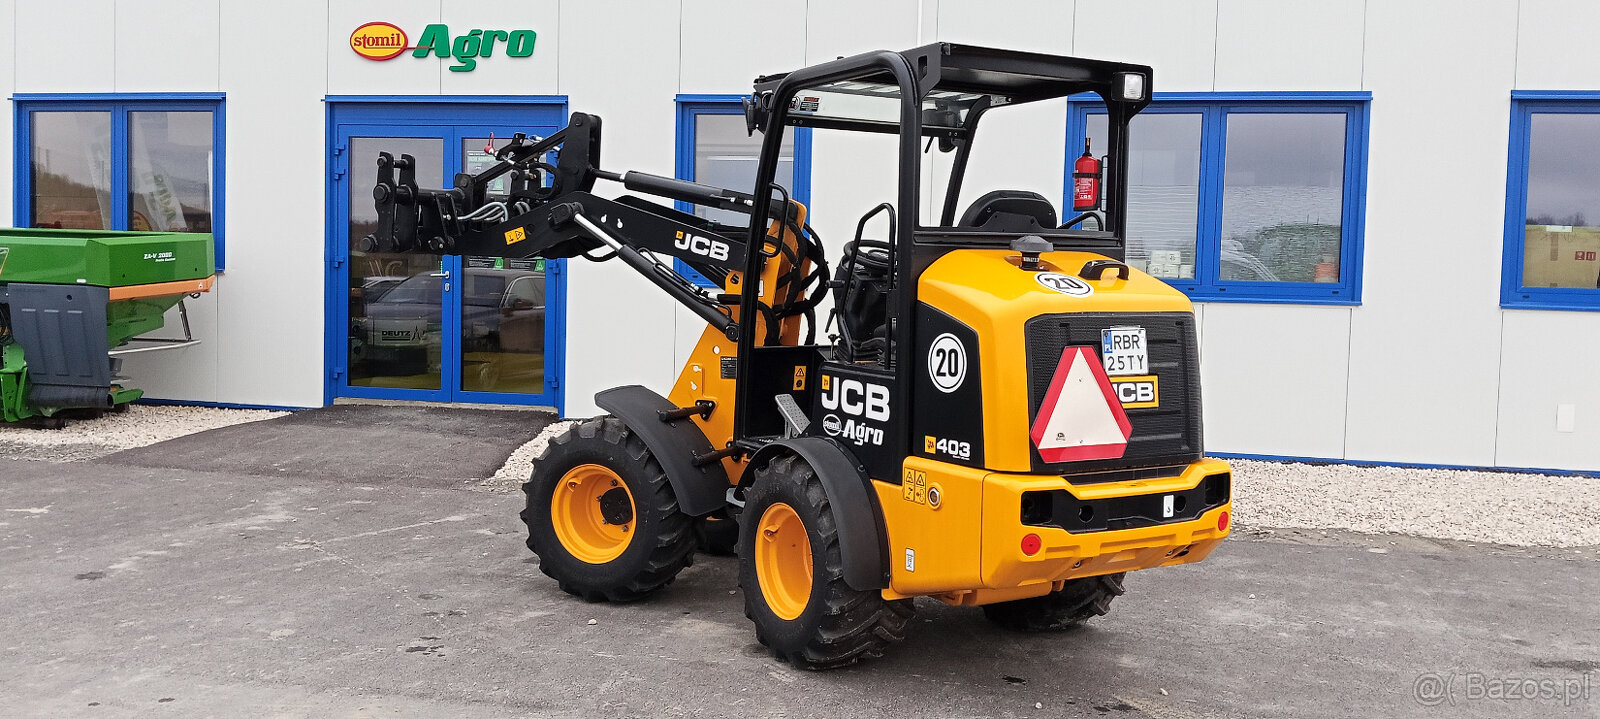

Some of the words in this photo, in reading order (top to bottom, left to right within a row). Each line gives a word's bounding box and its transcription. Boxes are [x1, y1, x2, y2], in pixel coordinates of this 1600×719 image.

[353, 33, 402, 48] stomil
[412, 23, 537, 72] Agro
[675, 231, 729, 262] JCB
[1044, 277, 1083, 290] 20
[1113, 334, 1140, 350] RBR
[935, 348, 959, 377] 20
[1107, 354, 1144, 371] 25TY
[821, 376, 891, 422] JCB
[842, 419, 884, 446] Agro
[936, 438, 971, 458] 403
